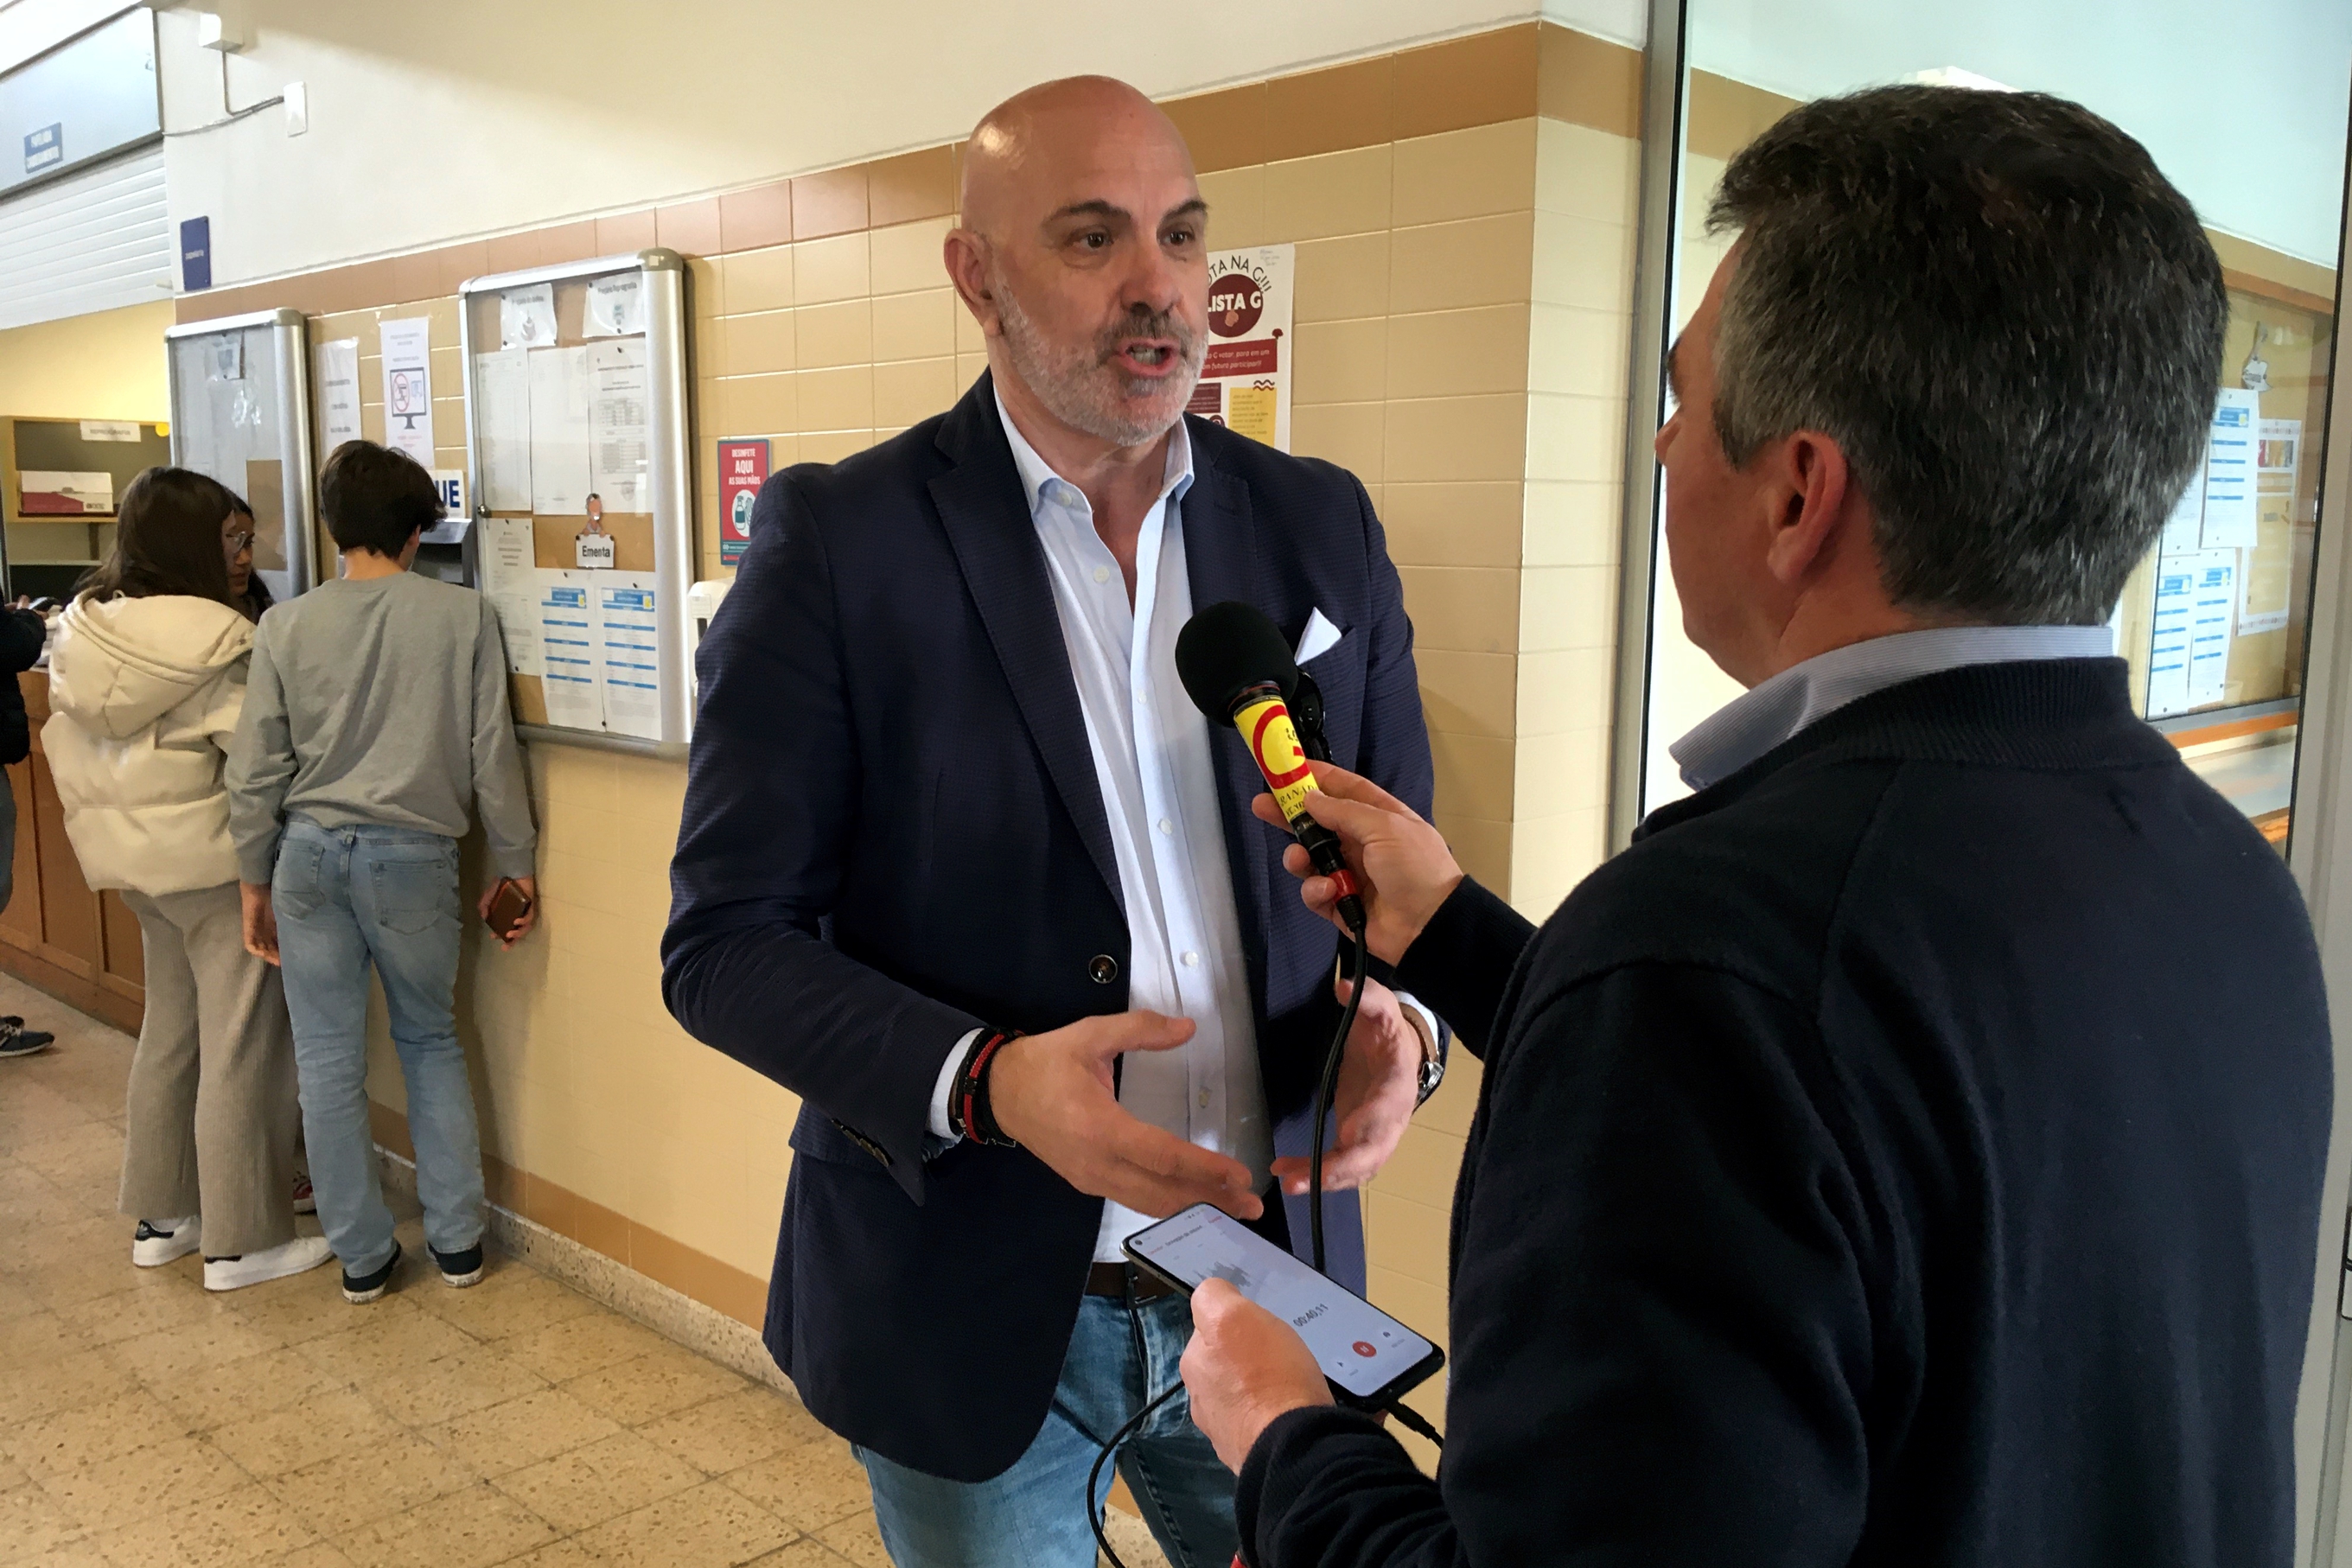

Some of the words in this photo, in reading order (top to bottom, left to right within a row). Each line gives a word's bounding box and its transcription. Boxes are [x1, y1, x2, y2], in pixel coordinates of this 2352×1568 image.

[1231, 255, 1249, 273] NA
[1250, 290, 1261, 309] G
[731, 448, 756, 458] DESINFETE
[735, 460, 754, 475] AQUI
[728, 476, 736, 486] AS
[736, 475, 748, 486] SUAS
[582, 545, 610, 558] Ementa
